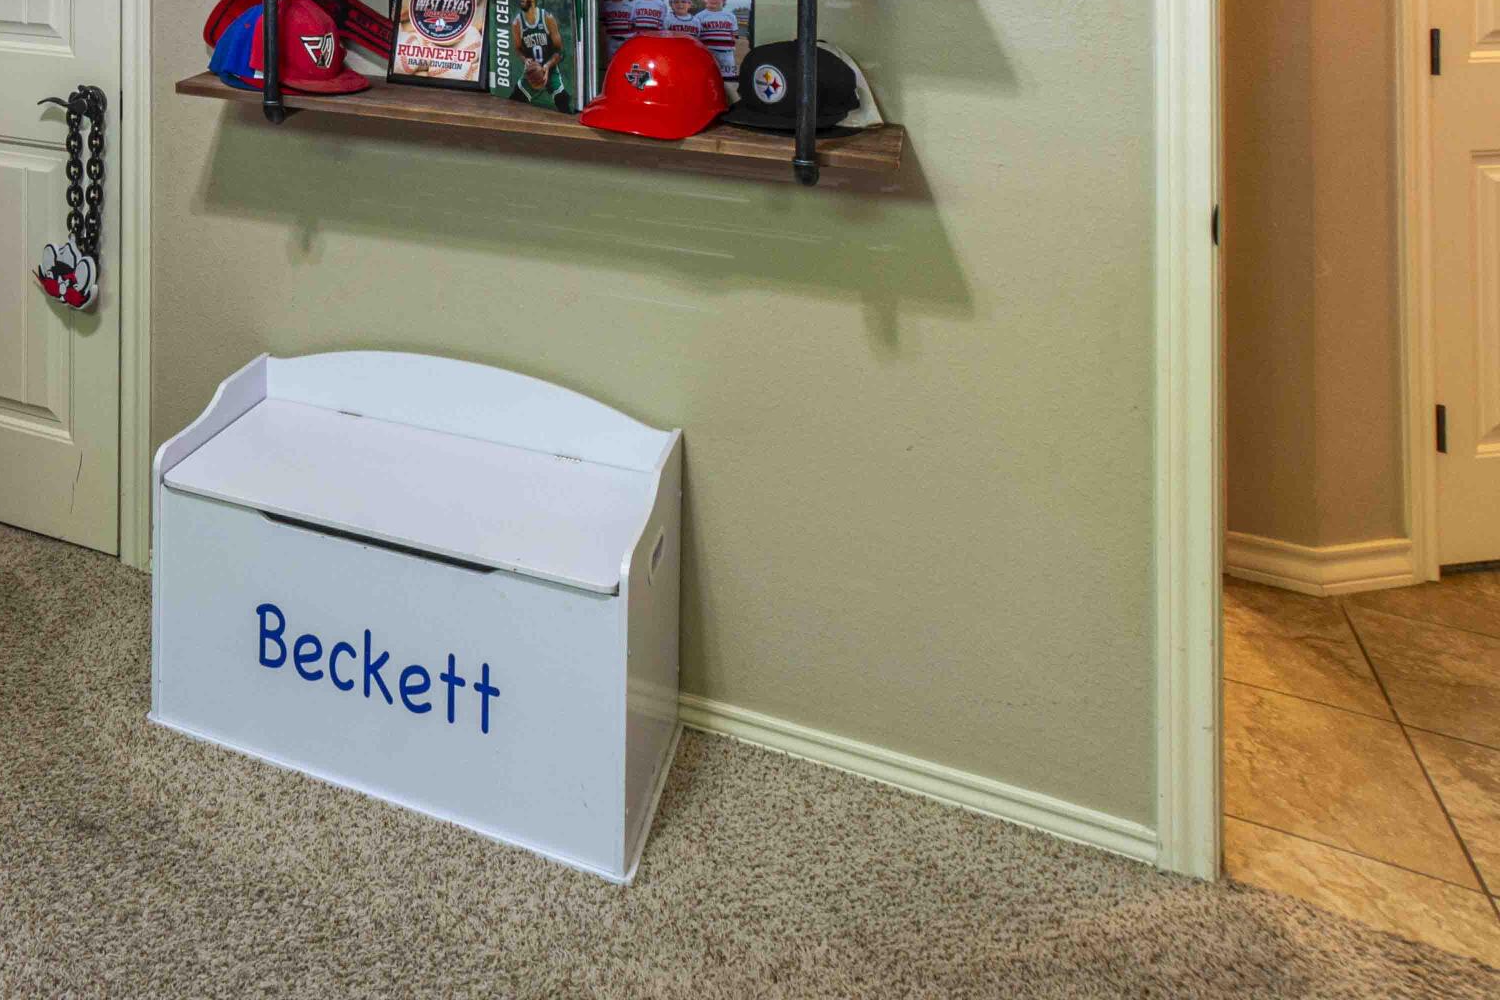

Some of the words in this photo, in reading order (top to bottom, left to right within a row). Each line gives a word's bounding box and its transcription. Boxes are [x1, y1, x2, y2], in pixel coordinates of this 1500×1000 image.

[442, 0, 471, 15] TEXAS
[397, 44, 476, 63] RUNNER-UP
[497, 28, 510, 88] BOSTON
[430, 60, 463, 70] DIVISION
[256, 603, 500, 734] Beckett
